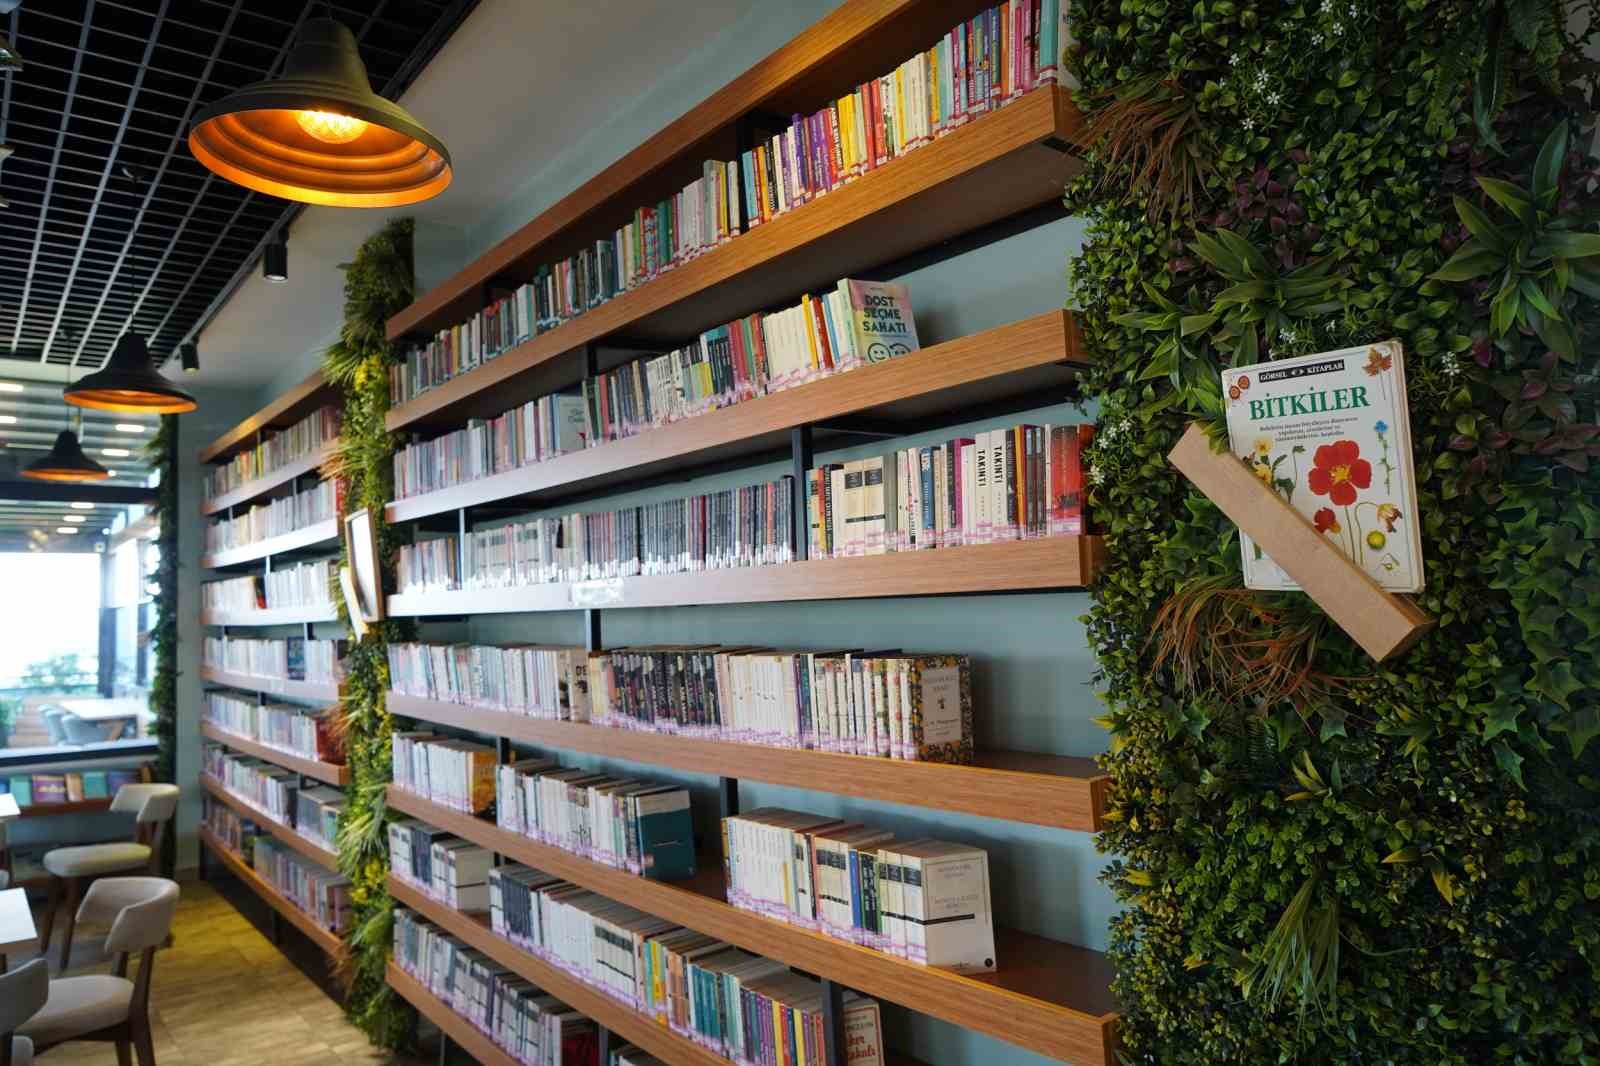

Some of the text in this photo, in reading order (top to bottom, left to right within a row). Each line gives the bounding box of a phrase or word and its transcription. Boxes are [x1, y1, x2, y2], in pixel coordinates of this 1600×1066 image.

[864, 294, 895, 307] DOST
[1260, 361, 1344, 381] GÖRSEL KİTAPLAR
[1249, 385, 1371, 420] BİTKİLER
